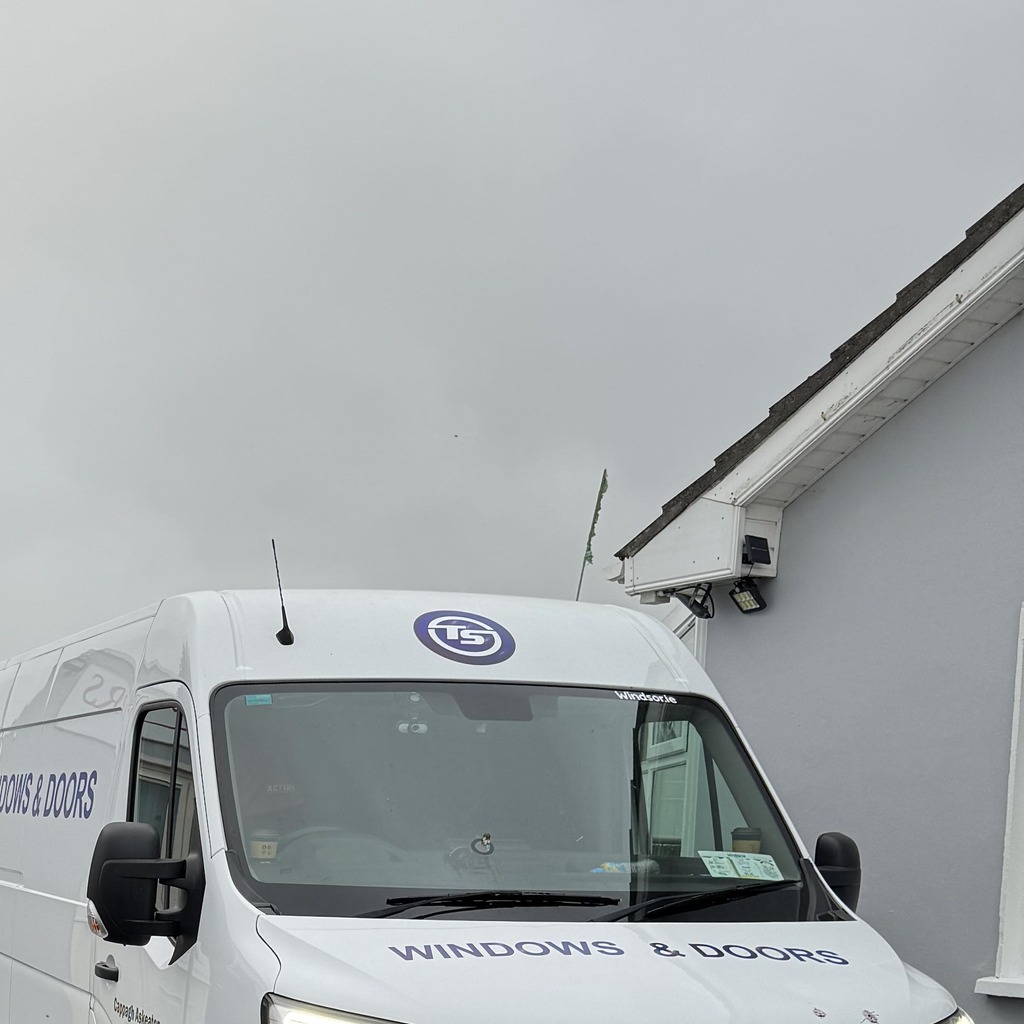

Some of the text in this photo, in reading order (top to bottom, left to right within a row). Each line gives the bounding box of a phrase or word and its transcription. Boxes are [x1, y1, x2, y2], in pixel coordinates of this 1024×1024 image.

[32, 774, 43, 818] &
[43, 770, 98, 820] DOORS
[388, 940, 850, 966] WINDOWS & DOORS
[113, 997, 135, 1023] Cappagh
